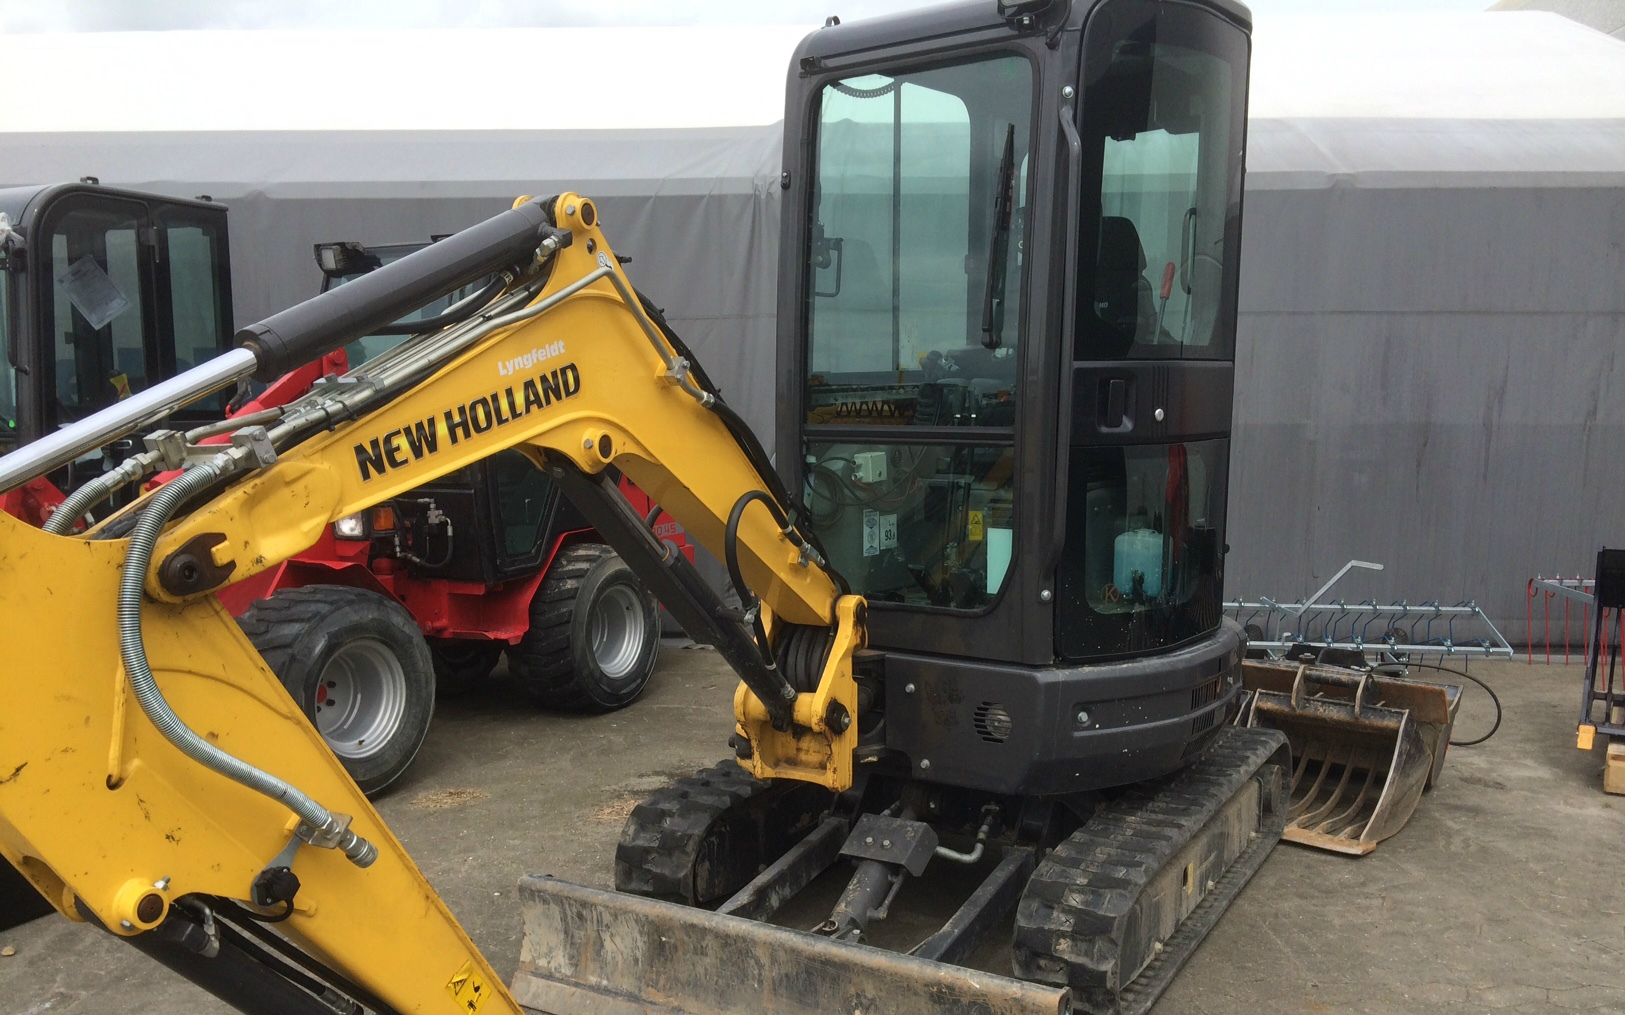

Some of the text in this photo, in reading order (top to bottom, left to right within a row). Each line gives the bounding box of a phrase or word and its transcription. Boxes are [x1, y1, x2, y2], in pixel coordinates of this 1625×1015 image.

[498, 339, 566, 376] Lyngfeldt
[353, 362, 581, 482] NEW HOLLAND
